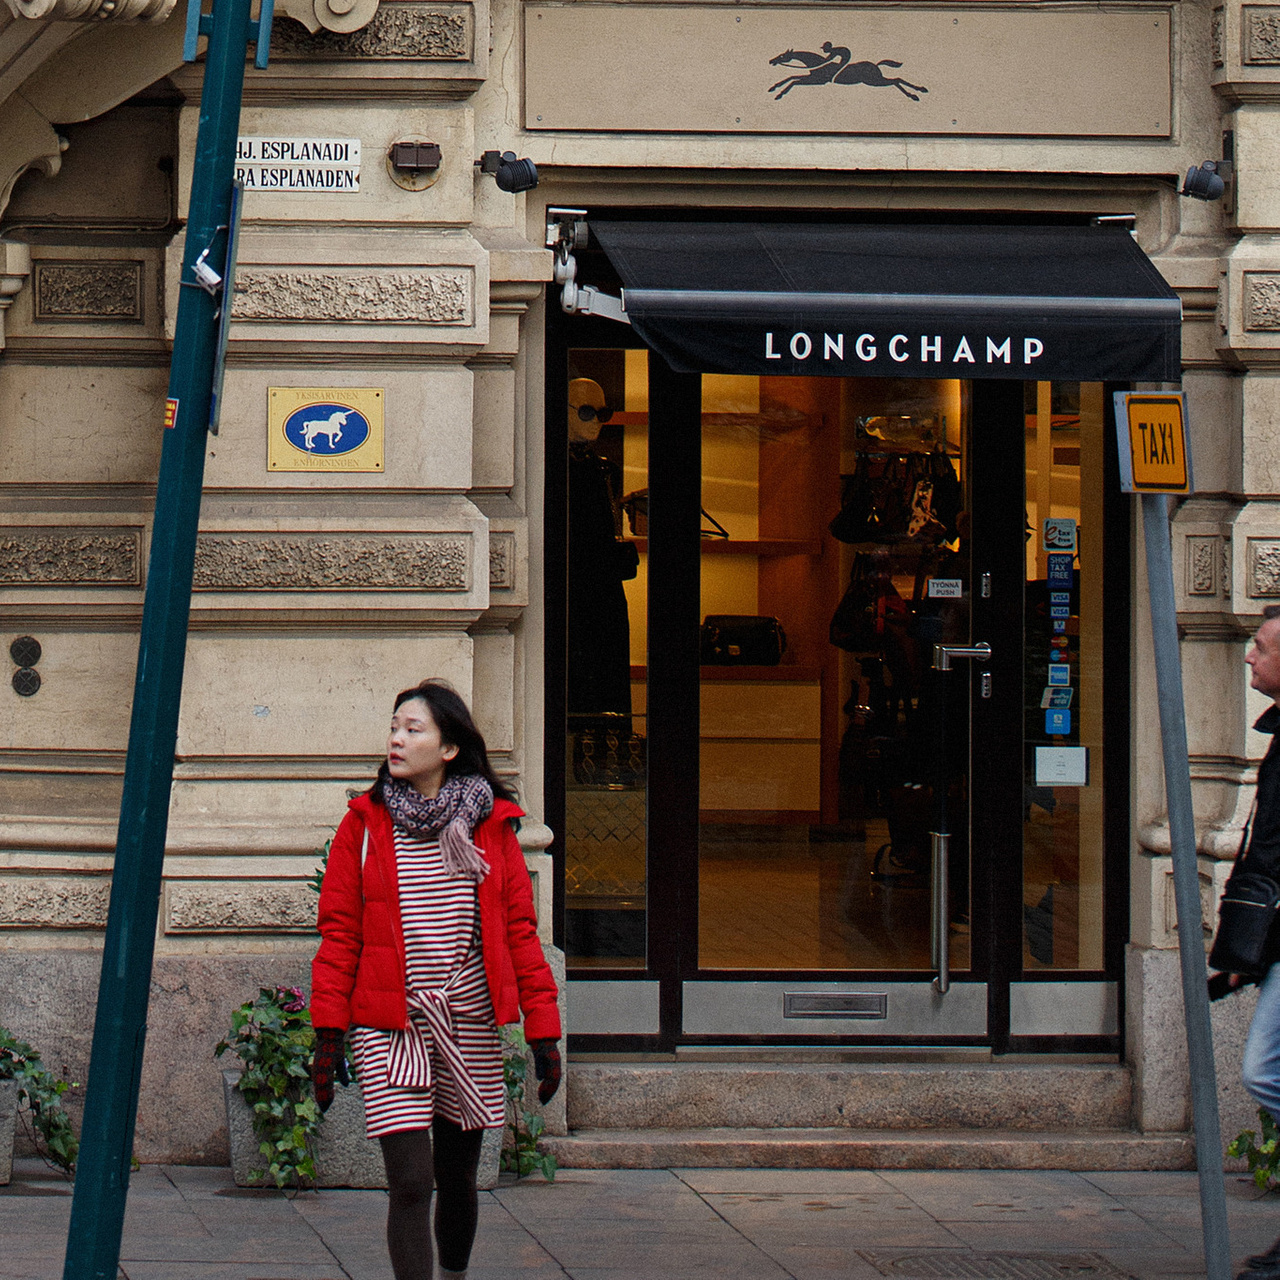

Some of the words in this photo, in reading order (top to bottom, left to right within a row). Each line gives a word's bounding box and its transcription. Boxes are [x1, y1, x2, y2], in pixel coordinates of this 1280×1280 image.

[261, 141, 349, 161] ESPLANADI
[260, 168, 354, 188] ESPLANADEN
[765, 331, 1044, 365] LONGCHAMP
[295, 391, 359, 400] YKSISARVINEN
[1138, 423, 1175, 465] TAXI
[1050, 556, 1071, 564] SHOP
[1050, 571, 1069, 579] FREE
